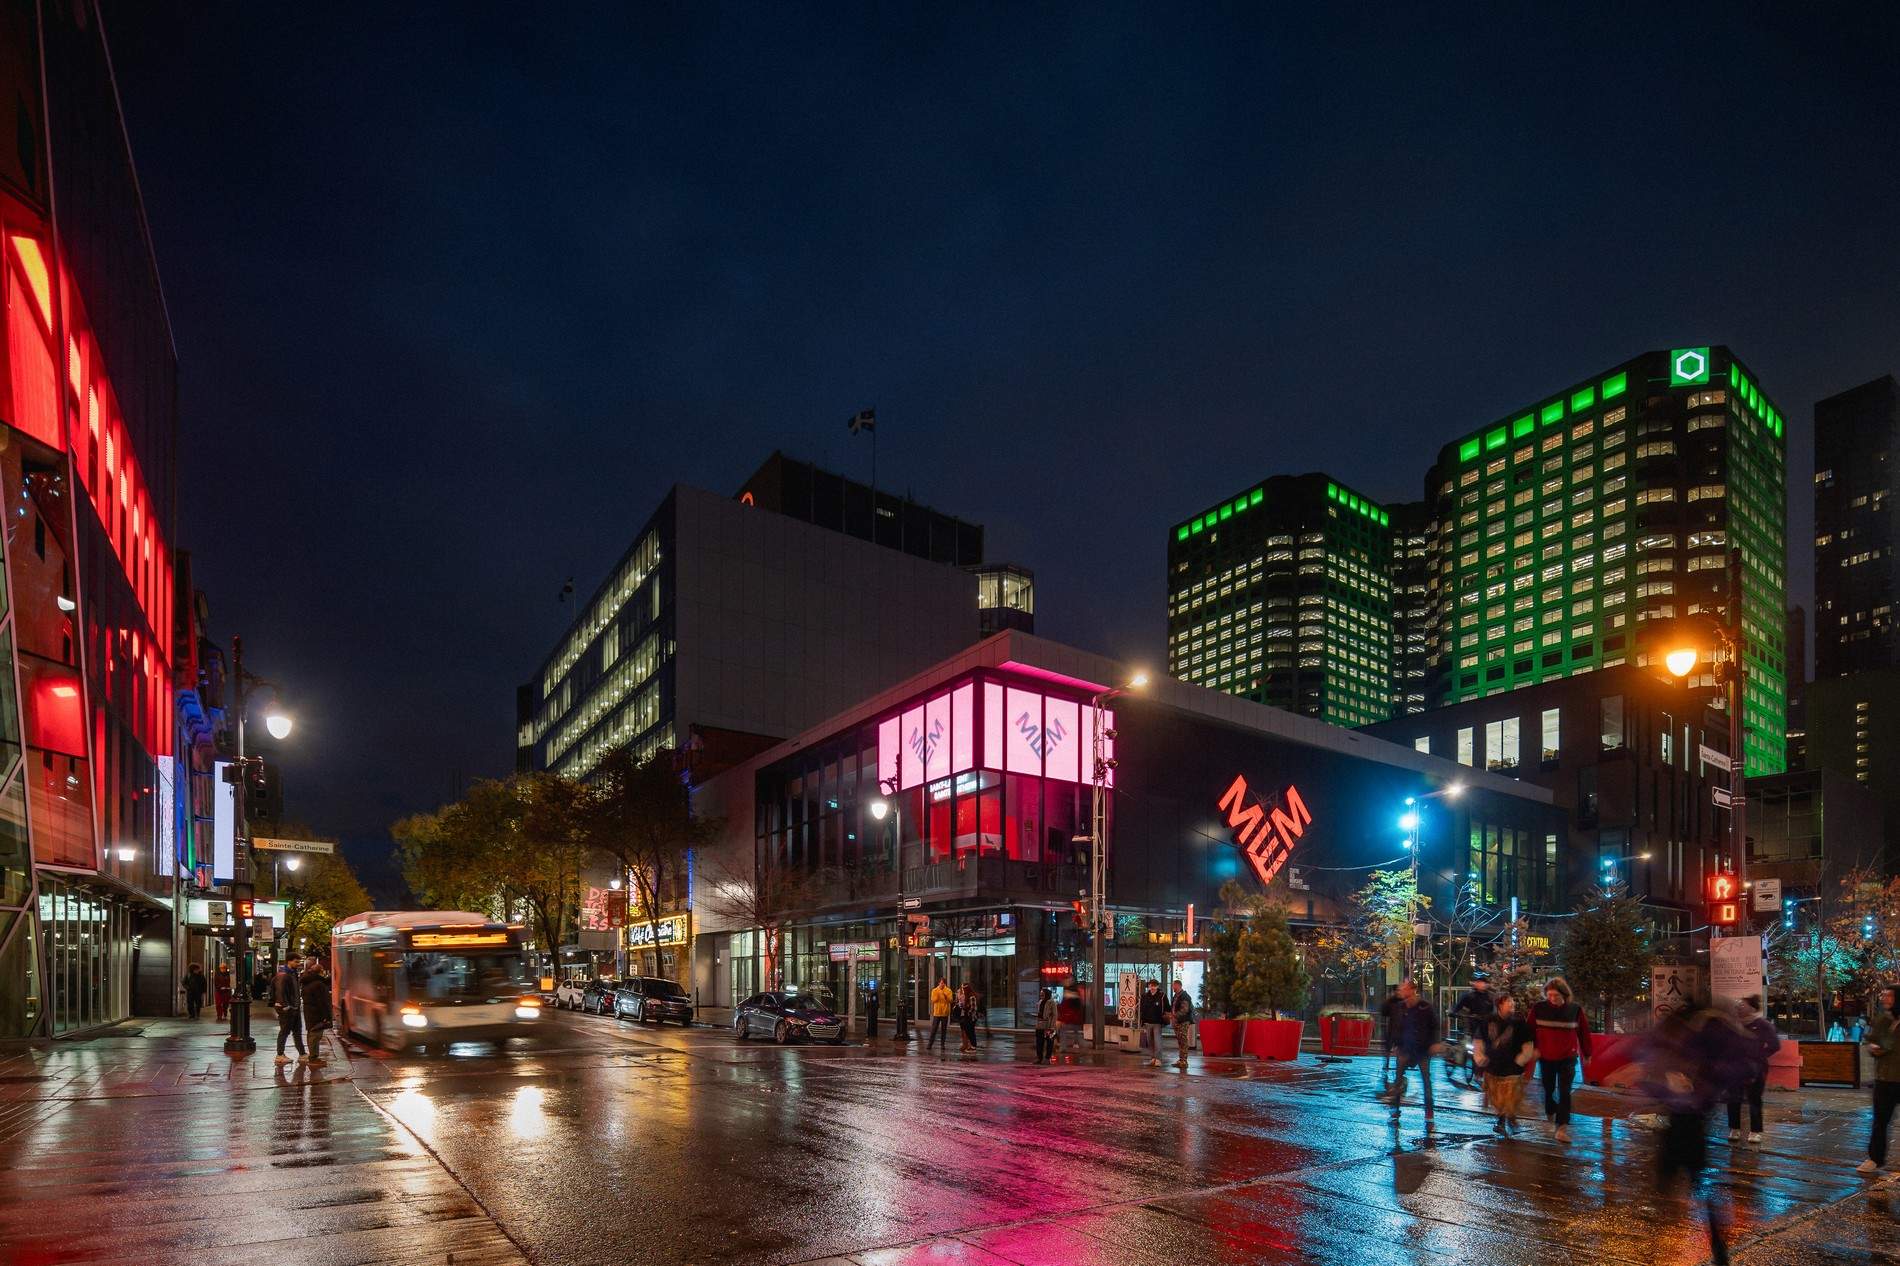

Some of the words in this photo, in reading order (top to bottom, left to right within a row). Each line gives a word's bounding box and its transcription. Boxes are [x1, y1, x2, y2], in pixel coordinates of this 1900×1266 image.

[909, 718, 945, 766] MEM
[1016, 711, 1068, 761] MEM
[268, 842, 330, 852] Sainte-Catherine
[1218, 774, 1312, 885] MEM
[242, 904, 252, 917] 5
